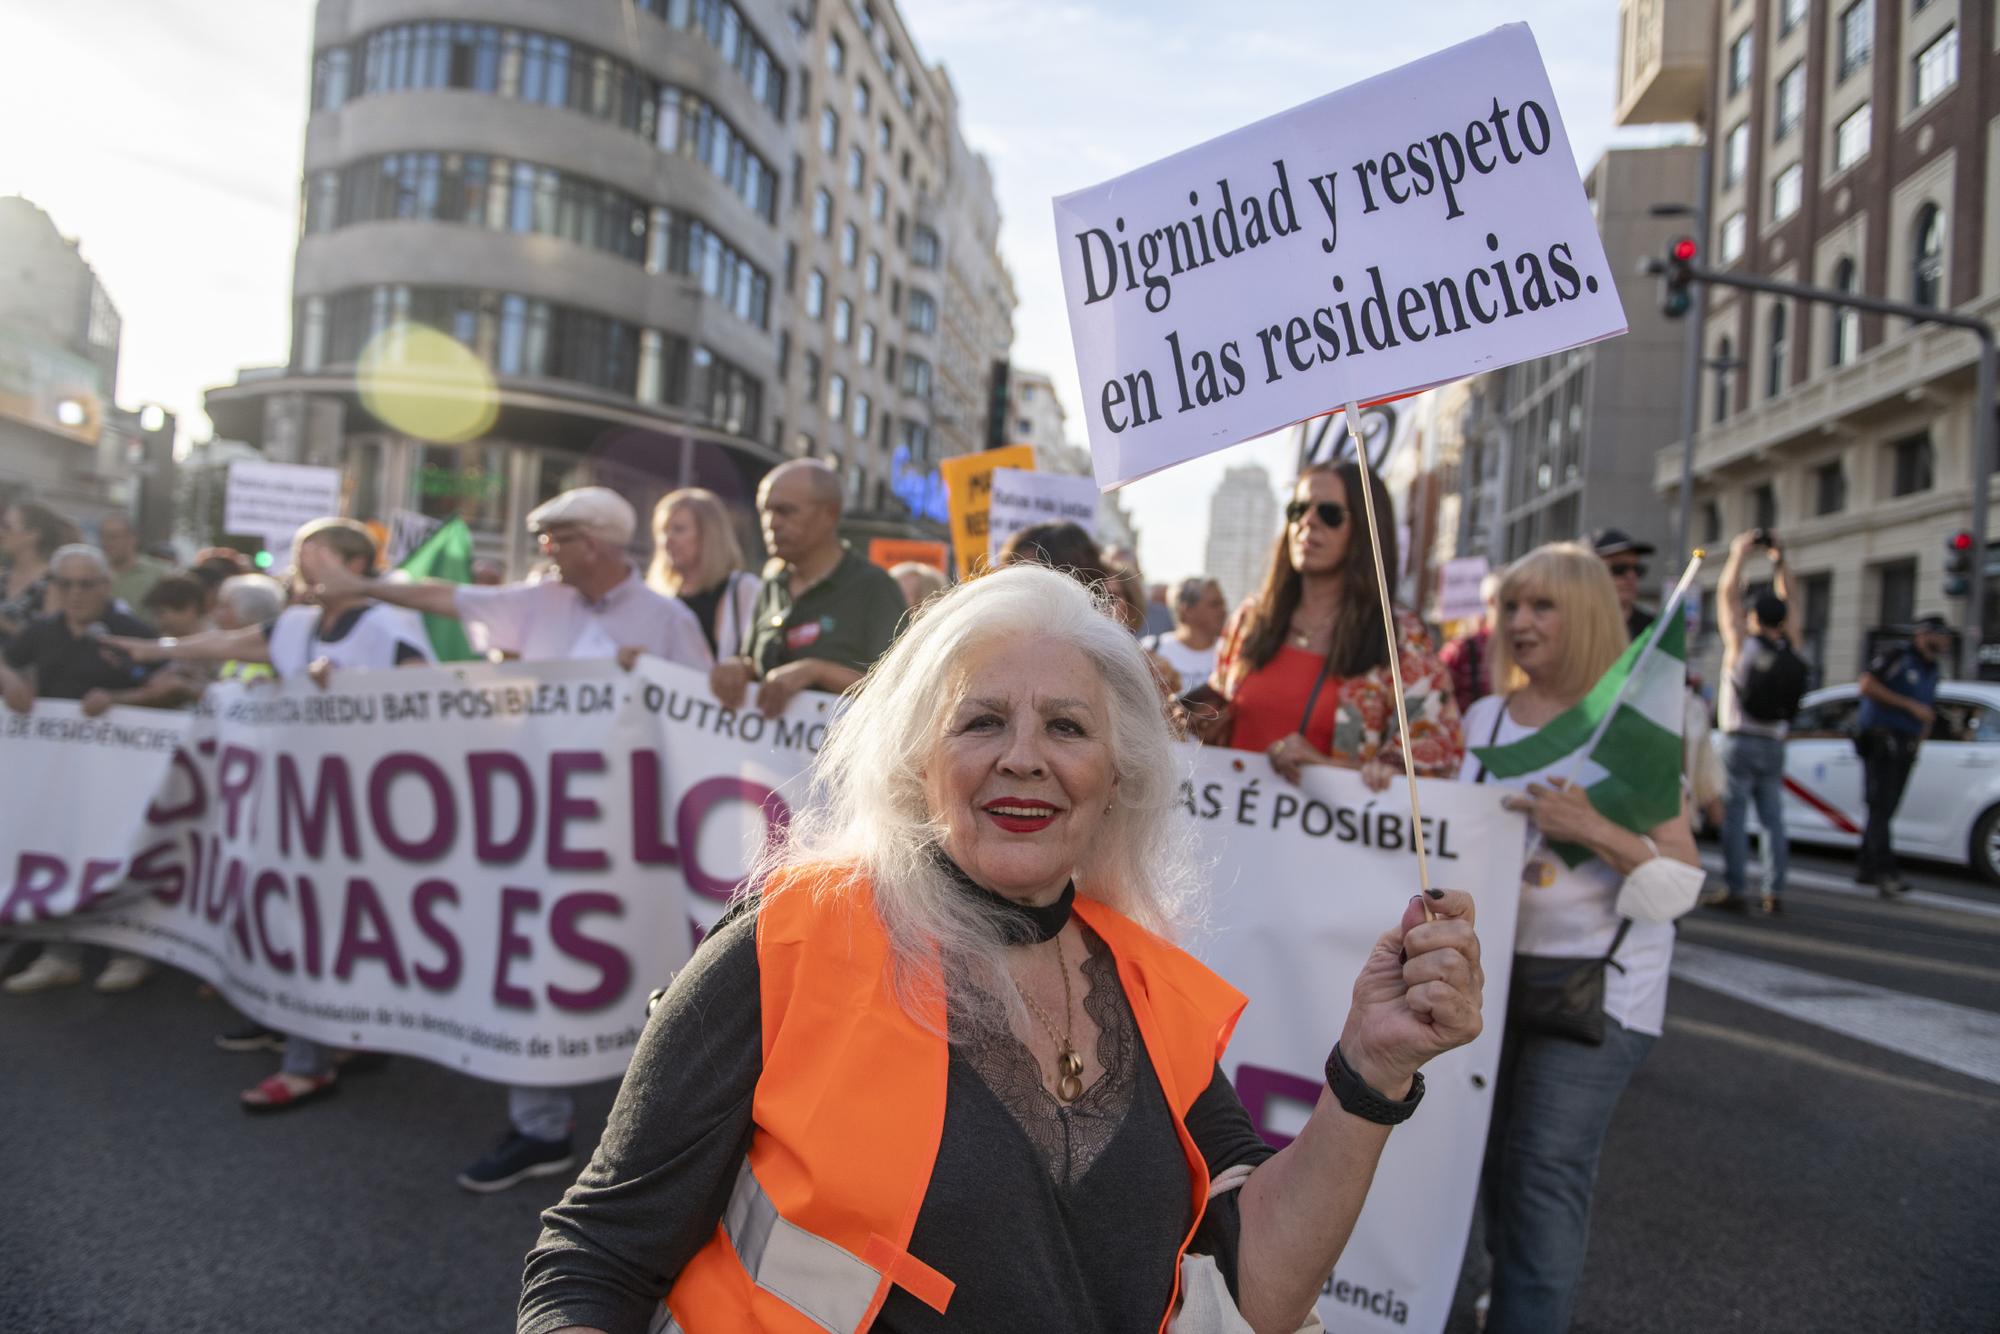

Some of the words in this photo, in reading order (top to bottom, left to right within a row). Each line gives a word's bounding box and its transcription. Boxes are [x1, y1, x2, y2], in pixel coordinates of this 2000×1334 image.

[1076, 159, 1302, 313] Dignidad
[1308, 171, 1338, 254] y
[1352, 96, 1551, 221] respeto
[1101, 369, 1163, 434] en
[1165, 330, 1247, 414] las
[1256, 232, 1599, 384] residencias.
[382, 690, 432, 721] BAT
[577, 683, 616, 714] DA
[643, 683, 765, 743] OUTRO
[1236, 778, 1261, 826] É
[1270, 792, 1459, 860] POSÍBEL
[492, 883, 635, 1014] ES
[526, 1032, 551, 1057] de
